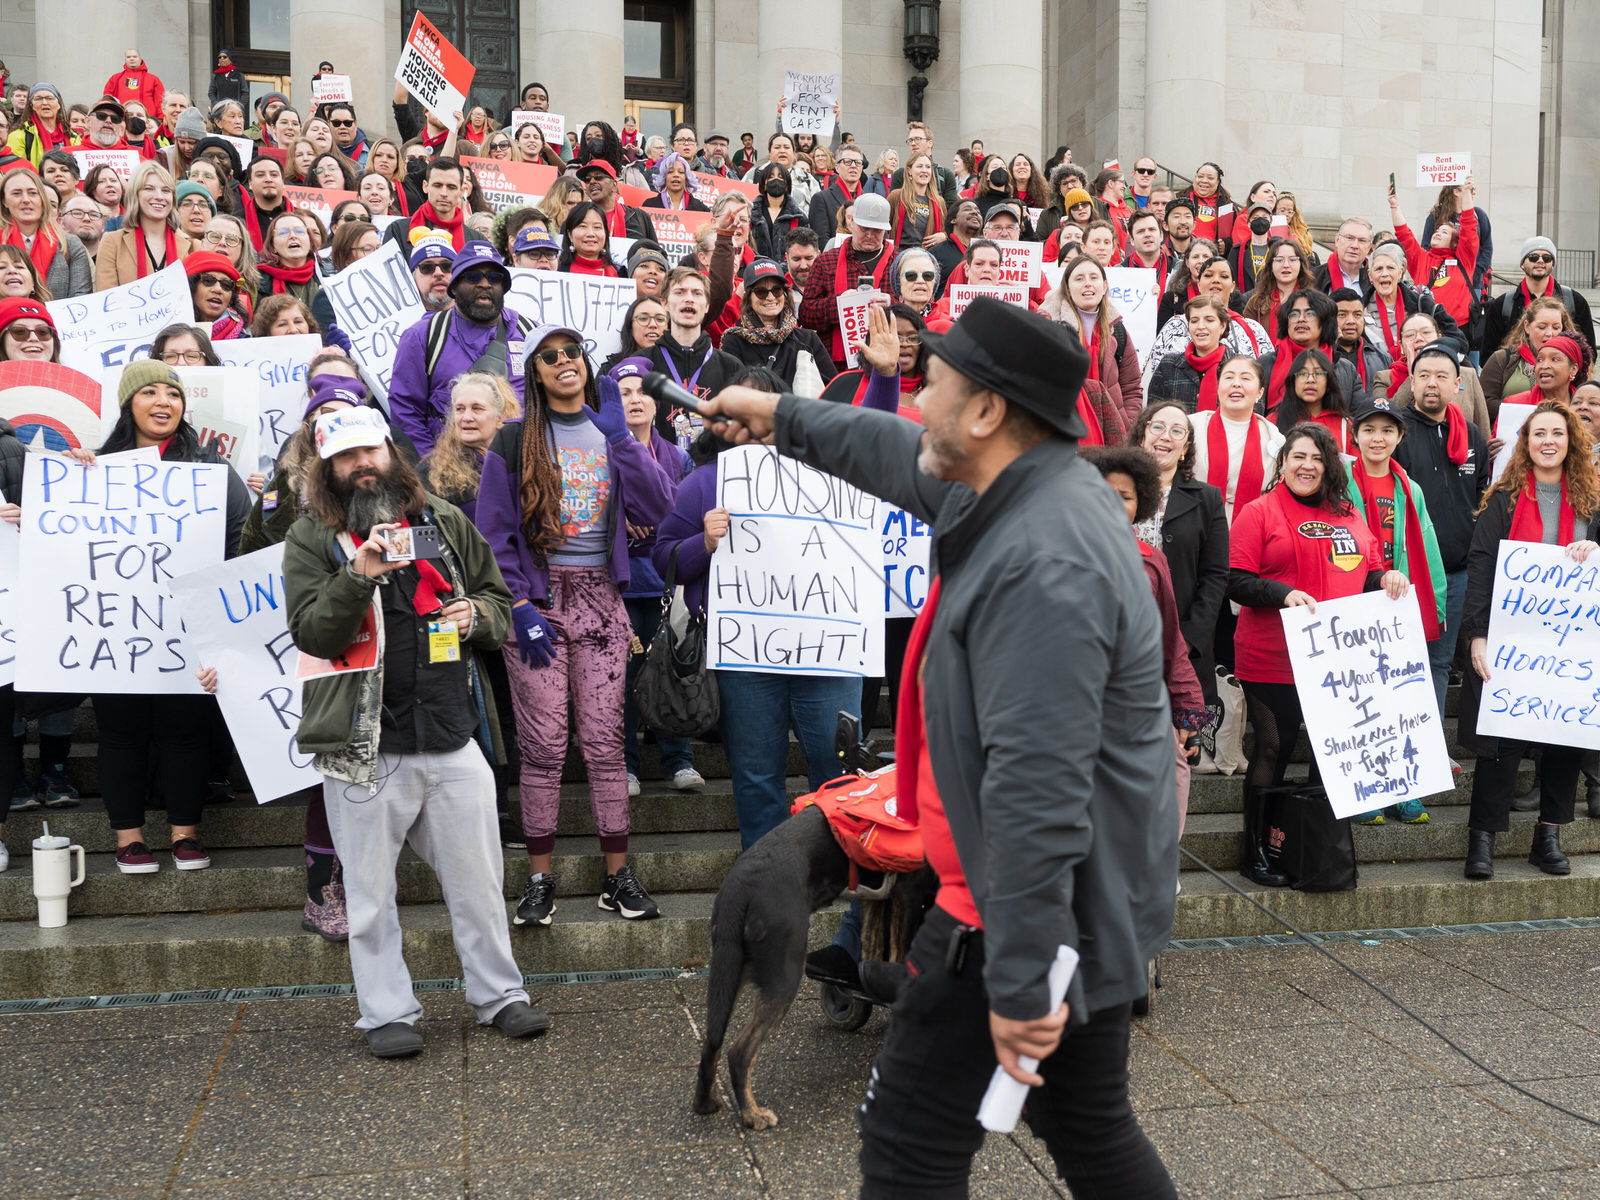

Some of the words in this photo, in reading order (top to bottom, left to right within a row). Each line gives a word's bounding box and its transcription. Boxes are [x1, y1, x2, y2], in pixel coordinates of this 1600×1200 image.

[416, 28, 425, 38] IS
[424, 36, 436, 50] ON
[435, 48, 441, 59] A
[420, 20, 440, 46] YWCA
[412, 36, 446, 73] MISSION:
[405, 61, 438, 95] JUSTICE
[409, 48, 447, 90] HOUSING
[788, 71, 834, 85] WORKING
[402, 69, 419, 90] FOR
[419, 87, 438, 108] ALL!
[793, 81, 832, 93] FOLKS
[798, 92, 822, 104] FOR
[790, 102, 829, 118] RENT
[790, 116, 822, 129] CAPS
[467, 161, 500, 172] YWCA
[1421, 164, 1466, 173] Stabilization
[1435, 156, 1452, 164] Rent
[480, 181, 517, 191] SSION:
[488, 171, 506, 180] ON
[507, 173, 516, 181] A
[1430, 172, 1457, 183] YES!
[286, 190, 324, 202] YWCA
[300, 201, 319, 210] ON
[483, 191, 524, 204] USING
[658, 222, 676, 231] ON
[677, 223, 687, 232] A
[998, 270, 1029, 282] OME
[1021, 261, 1028, 269] a
[1002, 292, 1023, 303] AND
[842, 306, 861, 356] HOME
[856, 305, 869, 340] Needs
[39, 457, 219, 515] PIERCE
[562, 471, 599, 482] NION
[560, 498, 599, 511] RIDE
[38, 510, 191, 543] COUNTY
[726, 518, 761, 555] IS
[801, 525, 828, 560] A
[881, 537, 907, 557] OR
[1333, 540, 1357, 554] IN
[88, 540, 175, 585] FOR
[1503, 546, 1600, 593] COMPA
[716, 564, 859, 615] HUMAN
[60, 583, 187, 635] REN
[1501, 586, 1600, 628] HOUSIN
[716, 616, 868, 667] RIGHT!
[1302, 621, 1325, 659] I
[59, 634, 187, 674] CAPS
[1494, 644, 1594, 682] HOMES
[1321, 670, 1343, 699] 4
[1375, 653, 1425, 685] freedom
[1350, 695, 1382, 729] I
[1399, 712, 1432, 735] have
[1339, 760, 1353, 777] to
[1354, 746, 1399, 778] fight
[1402, 734, 1420, 765] 4
[1353, 763, 1420, 802] Housing!!
